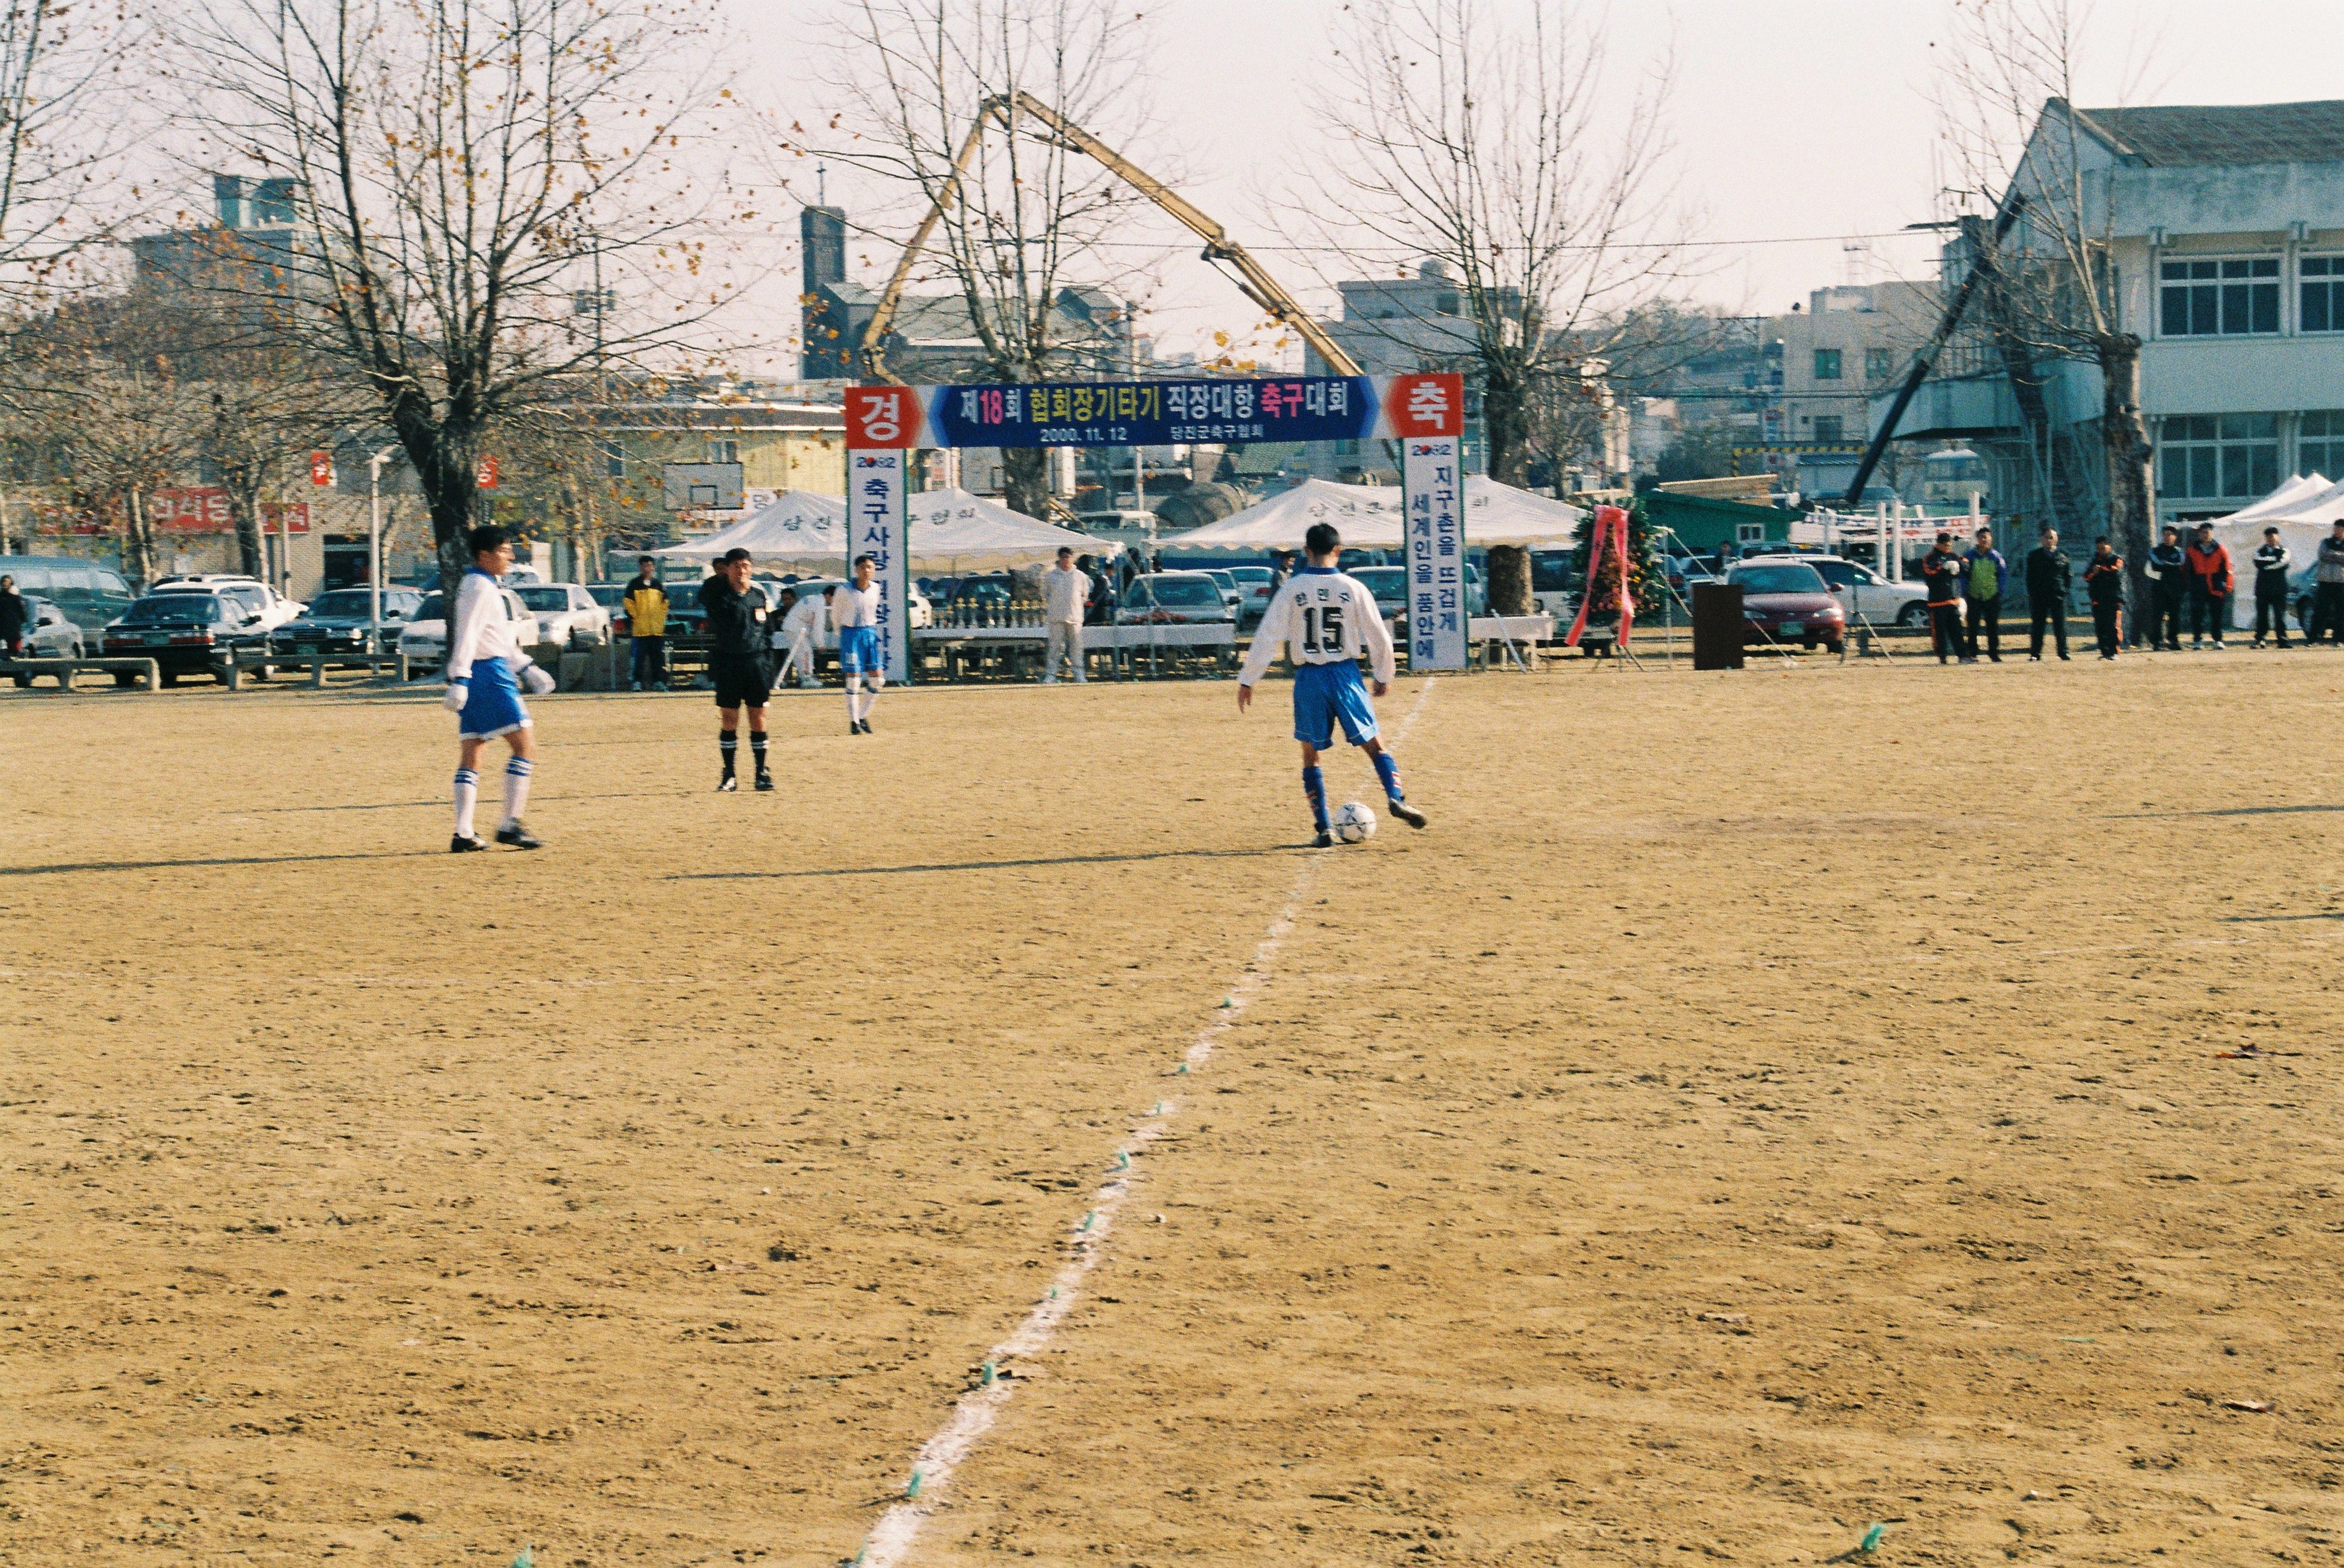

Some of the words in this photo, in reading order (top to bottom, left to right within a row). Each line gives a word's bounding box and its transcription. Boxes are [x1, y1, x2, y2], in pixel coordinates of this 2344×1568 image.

[860, 393, 900, 441] 경
[960, 389, 1022, 424] 제18회
[1029, 385, 1160, 423] 협회장기타기
[1167, 384, 1255, 420] 직장대항
[1261, 381, 1348, 418] 축구대회
[1408, 381, 1449, 430] 축
[1434, 465, 1457, 556] 지구촌을
[1411, 493, 1433, 584] 세계인을
[1438, 566, 1458, 632] 뜨겁게
[1303, 606, 1344, 654] 15
